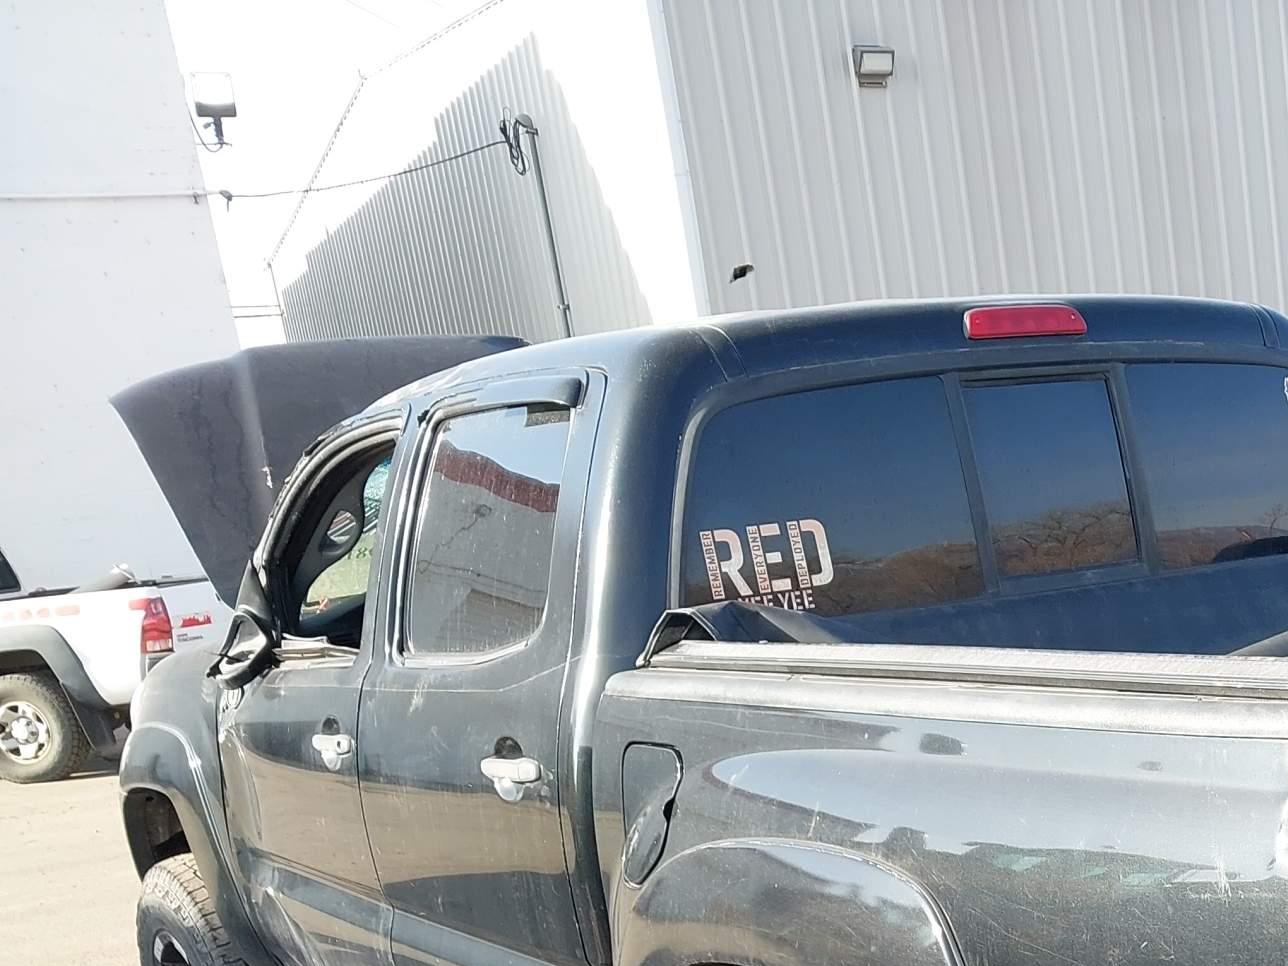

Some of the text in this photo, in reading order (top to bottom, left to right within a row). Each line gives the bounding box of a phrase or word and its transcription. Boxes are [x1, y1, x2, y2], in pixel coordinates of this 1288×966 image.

[699, 519, 834, 600] RED
[701, 532, 722, 598] REMEMBER
[747, 527, 769, 591] EVERYONE
[788, 523, 810, 586] DEPLOYED
[777, 589, 816, 611] YEE
